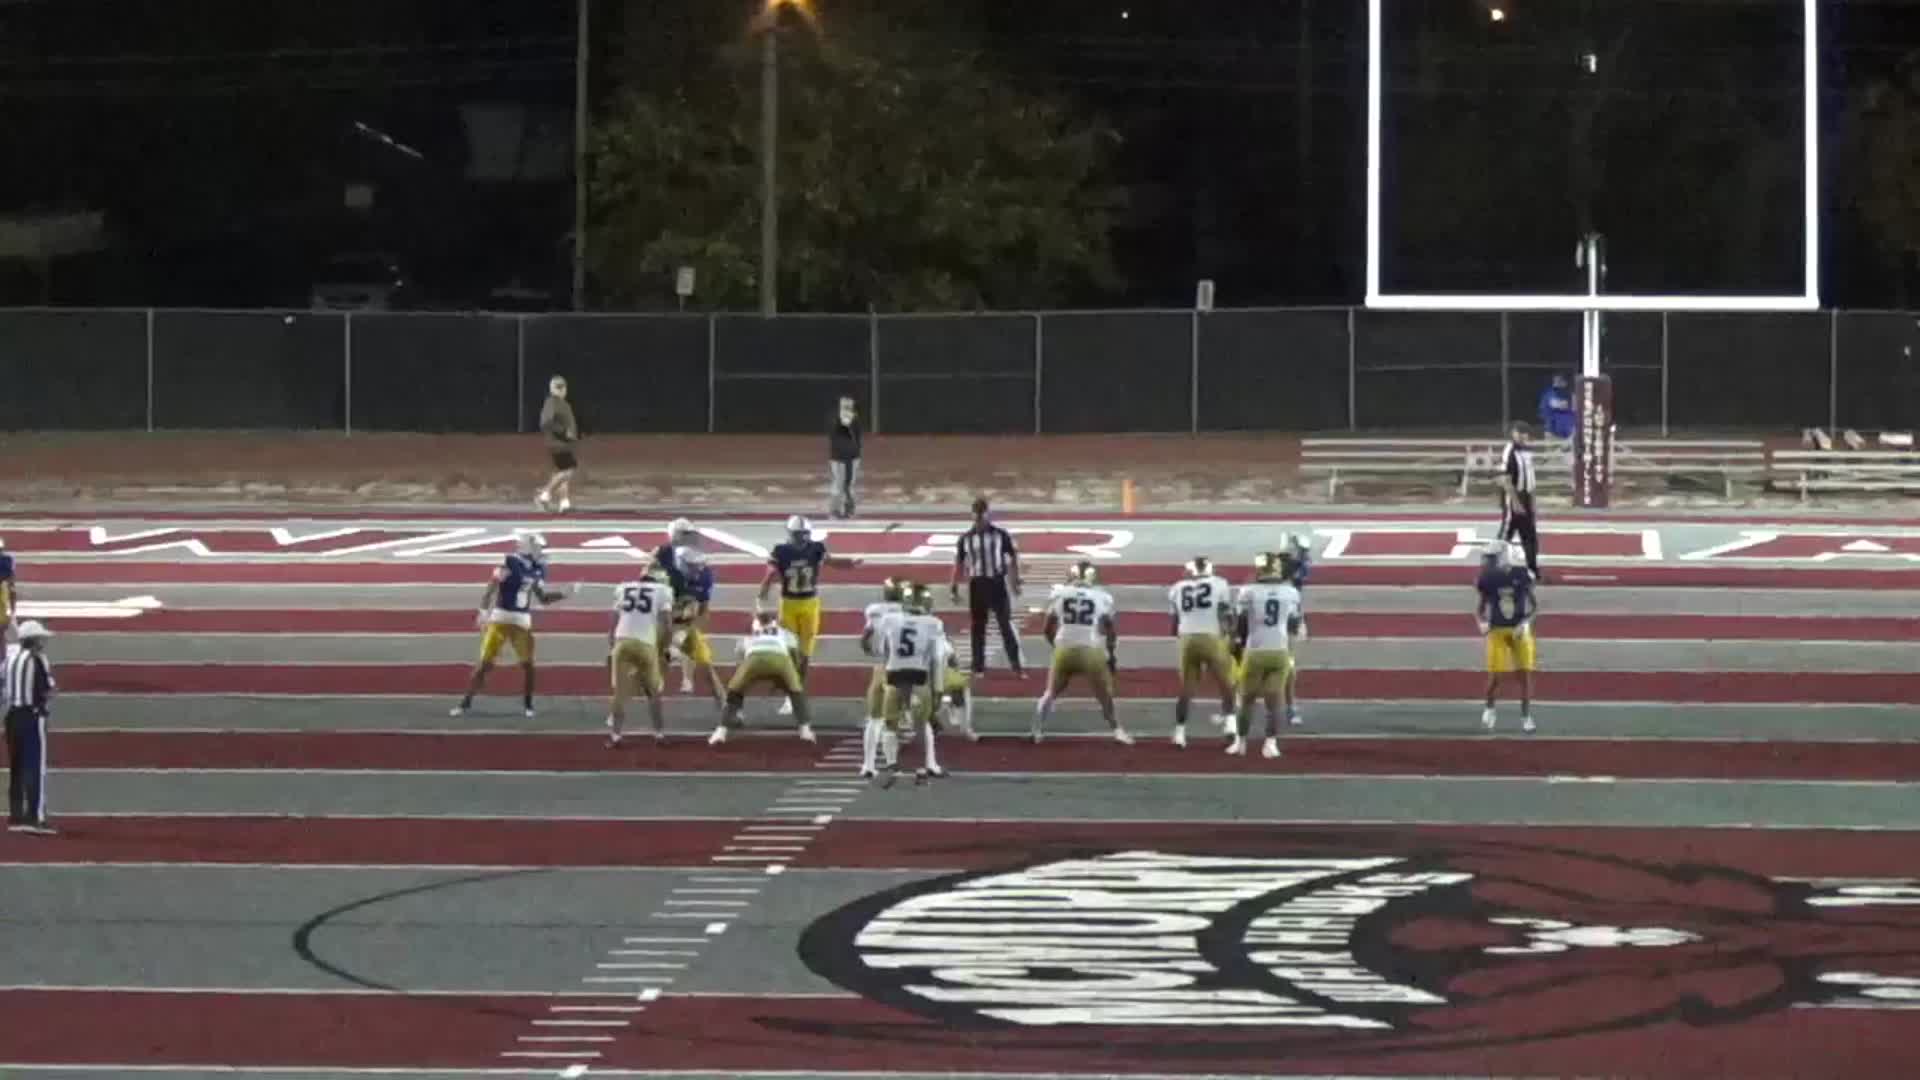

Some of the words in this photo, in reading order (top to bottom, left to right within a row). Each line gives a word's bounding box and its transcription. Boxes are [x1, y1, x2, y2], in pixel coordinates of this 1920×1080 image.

[623, 587, 654, 614] 55
[1181, 582, 1212, 612] 62
[1063, 598, 1095, 626] 52
[1264, 598, 1280, 627] 9
[897, 628, 917, 657] 5
[1242, 872, 1474, 945] HAWKS
[1246, 950, 1449, 1003] WAR
